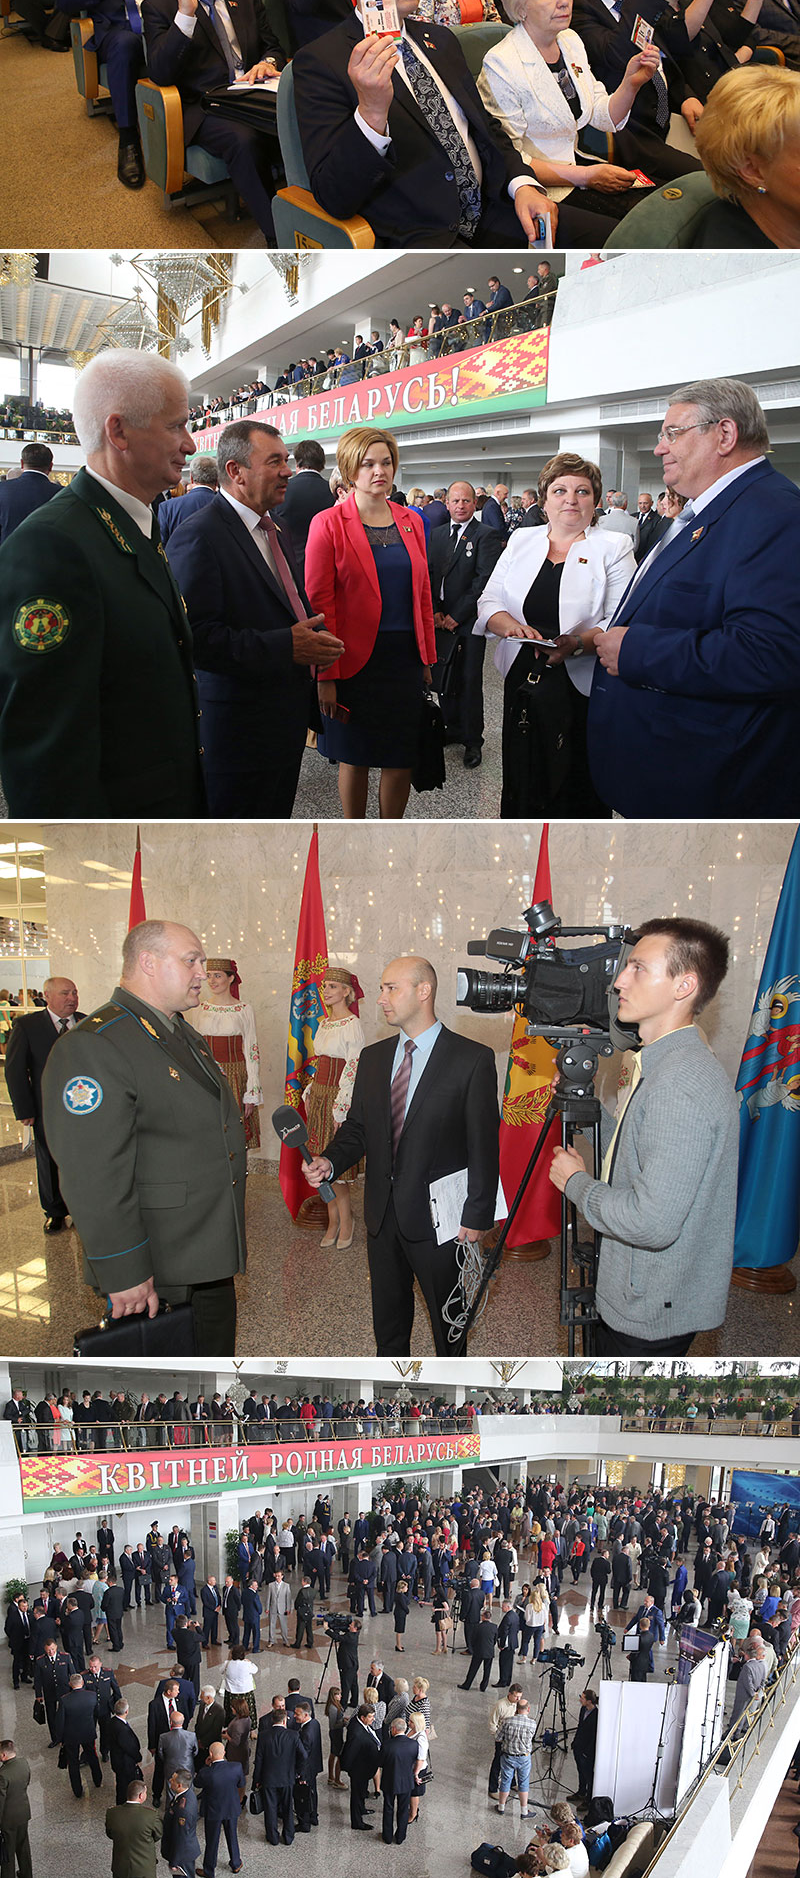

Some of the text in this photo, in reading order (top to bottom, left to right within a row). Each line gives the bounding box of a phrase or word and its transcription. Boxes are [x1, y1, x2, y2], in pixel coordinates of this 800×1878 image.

[306, 366, 460, 433] БЕЛАРУСЬ!
[98, 1440, 458, 1495] КВІТНЕЙ, РОДНАЯ БЕЛАРУСЬ!
